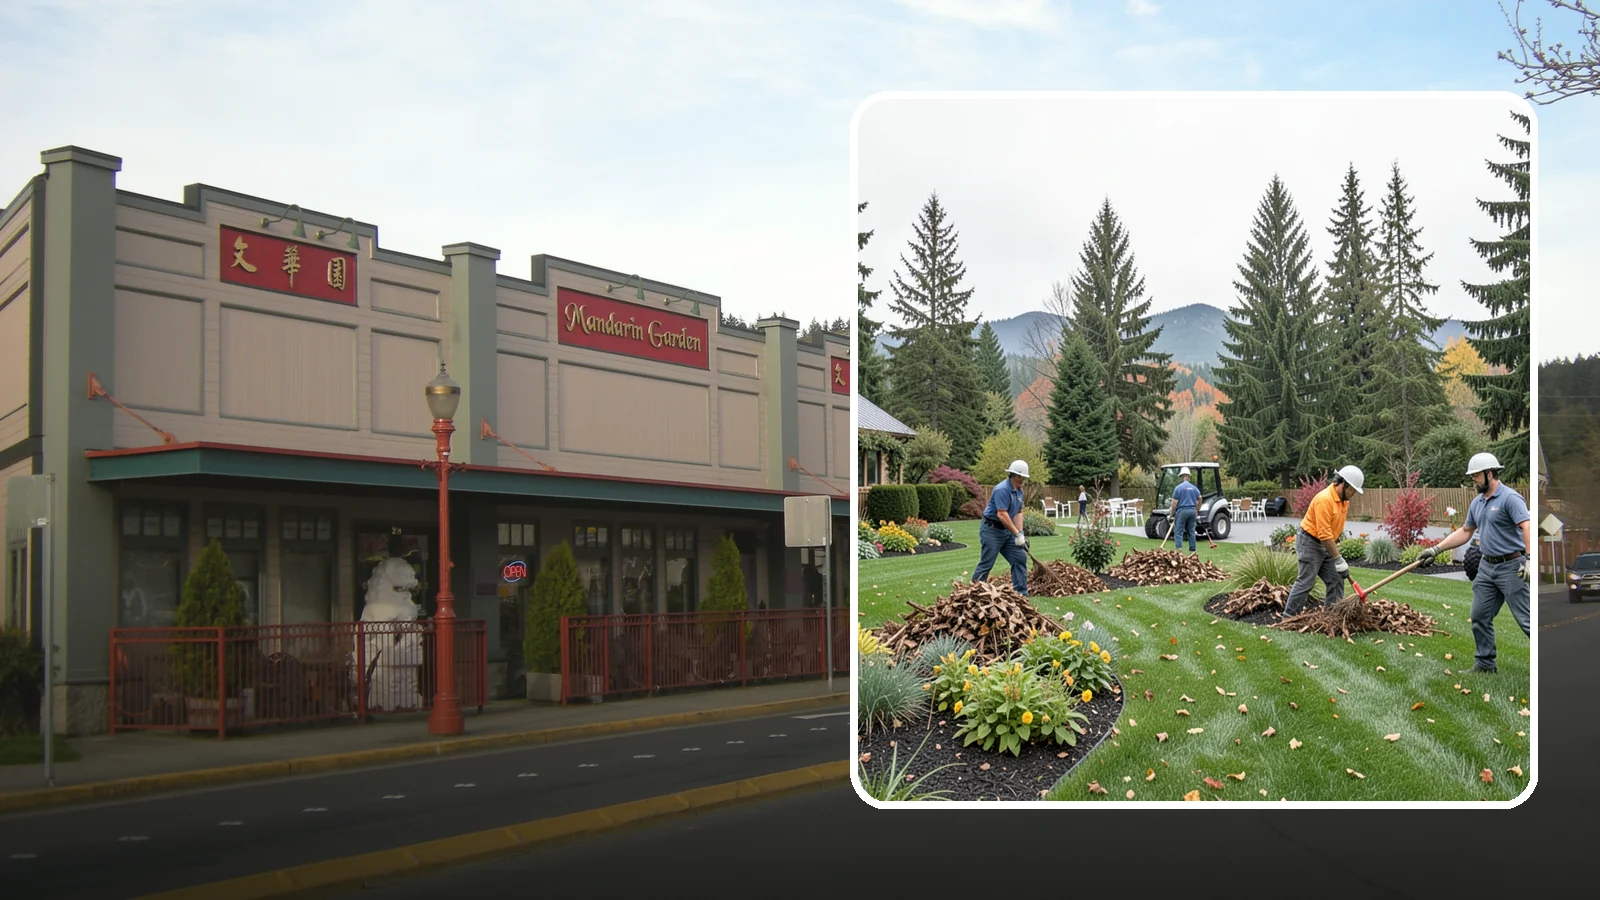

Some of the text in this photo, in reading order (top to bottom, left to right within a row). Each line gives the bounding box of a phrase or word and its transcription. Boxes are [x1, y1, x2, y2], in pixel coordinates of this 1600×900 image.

[230, 235, 346, 291] 文華園
[564, 302, 701, 352] Mandarin Garden
[834, 363, 847, 386] 文
[503, 565, 527, 578] OPEN
